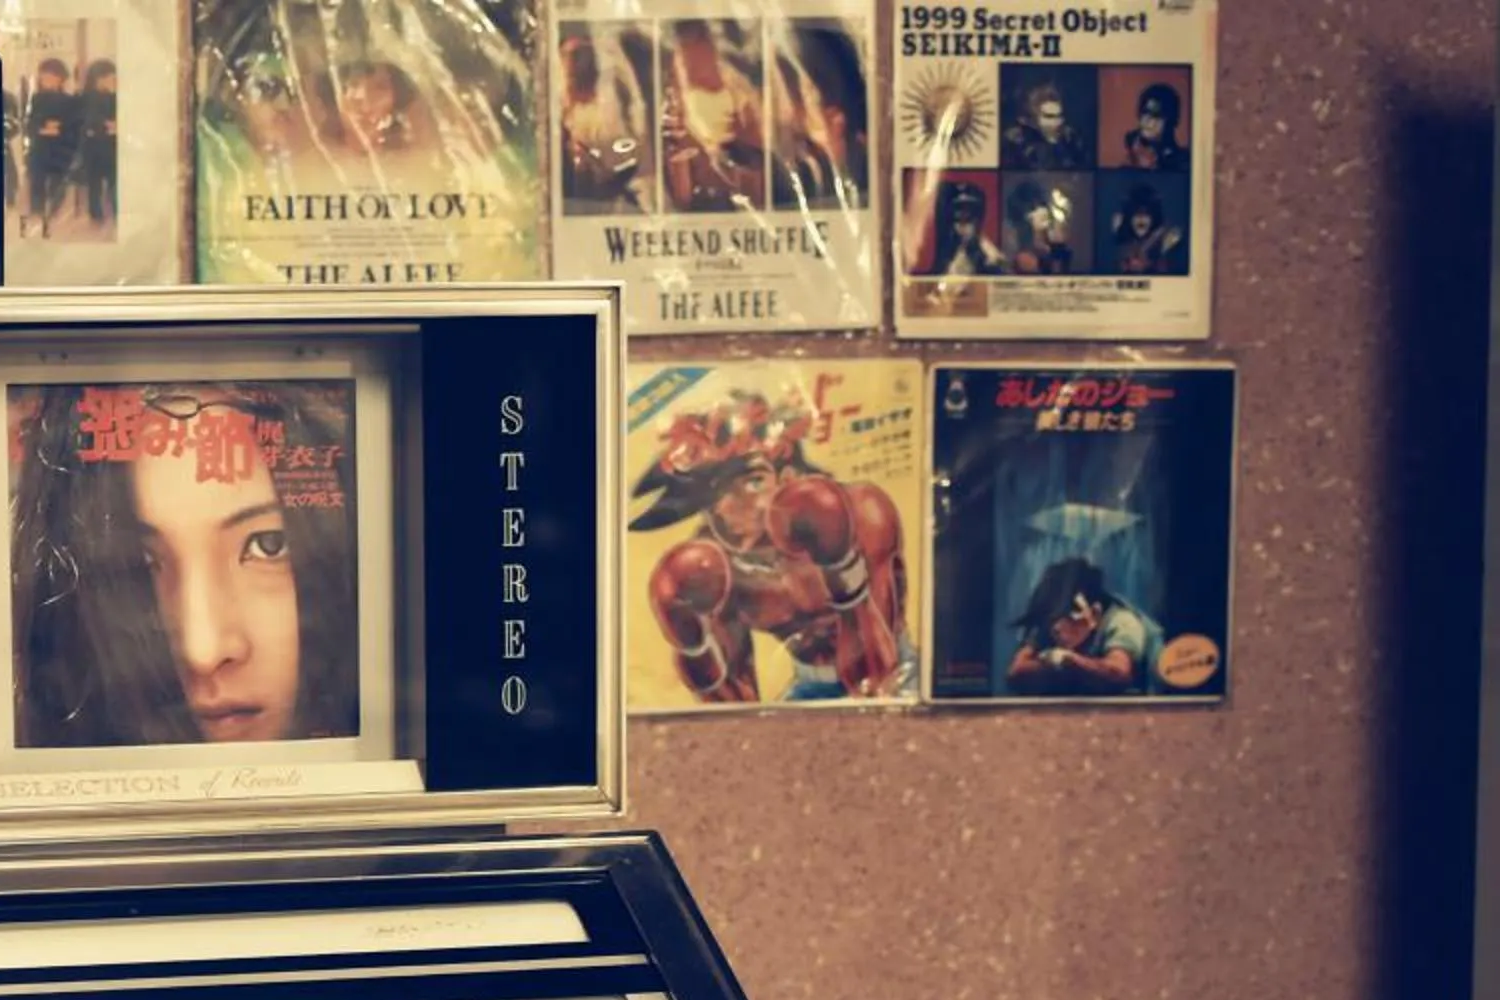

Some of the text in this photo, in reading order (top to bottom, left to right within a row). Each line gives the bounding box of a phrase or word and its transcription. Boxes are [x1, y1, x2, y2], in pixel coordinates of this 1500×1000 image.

[901, 7, 1147, 37] 1999 Secret Object
[245, 194, 347, 220] FAITH
[605, 226, 721, 263] WEEKEND
[277, 264, 349, 284] THE
[659, 290, 777, 320] THE ALFEE
[500, 395, 529, 715] STEREO
